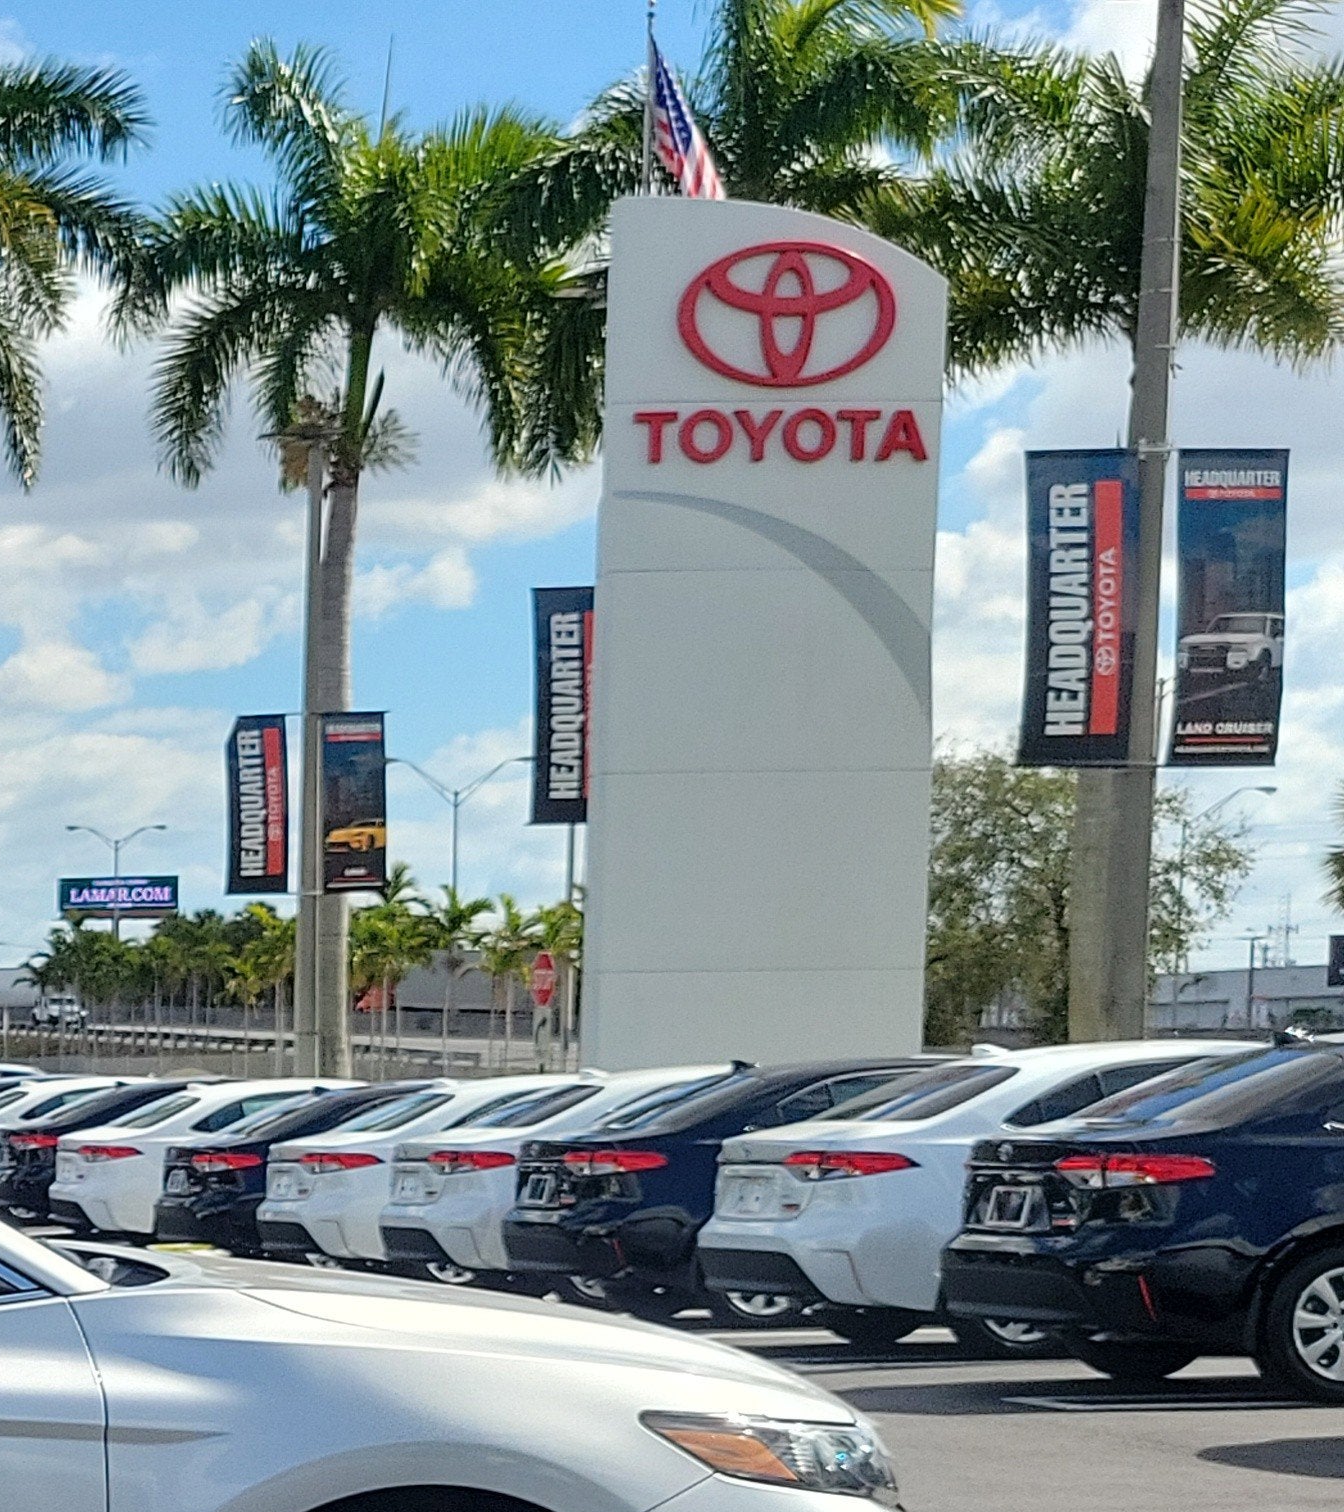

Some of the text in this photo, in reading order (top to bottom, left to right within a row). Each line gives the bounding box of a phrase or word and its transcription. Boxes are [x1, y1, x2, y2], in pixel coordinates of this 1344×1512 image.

[633, 408, 928, 463] TOYOTA
[1044, 482, 1093, 736] HEADQUARTER
[1097, 547, 1122, 642] TOYOTA
[548, 612, 584, 799] HEADQUARTER
[237, 729, 267, 877] HEADQUARTER
[69, 886, 171, 903] LAMAR.COM
